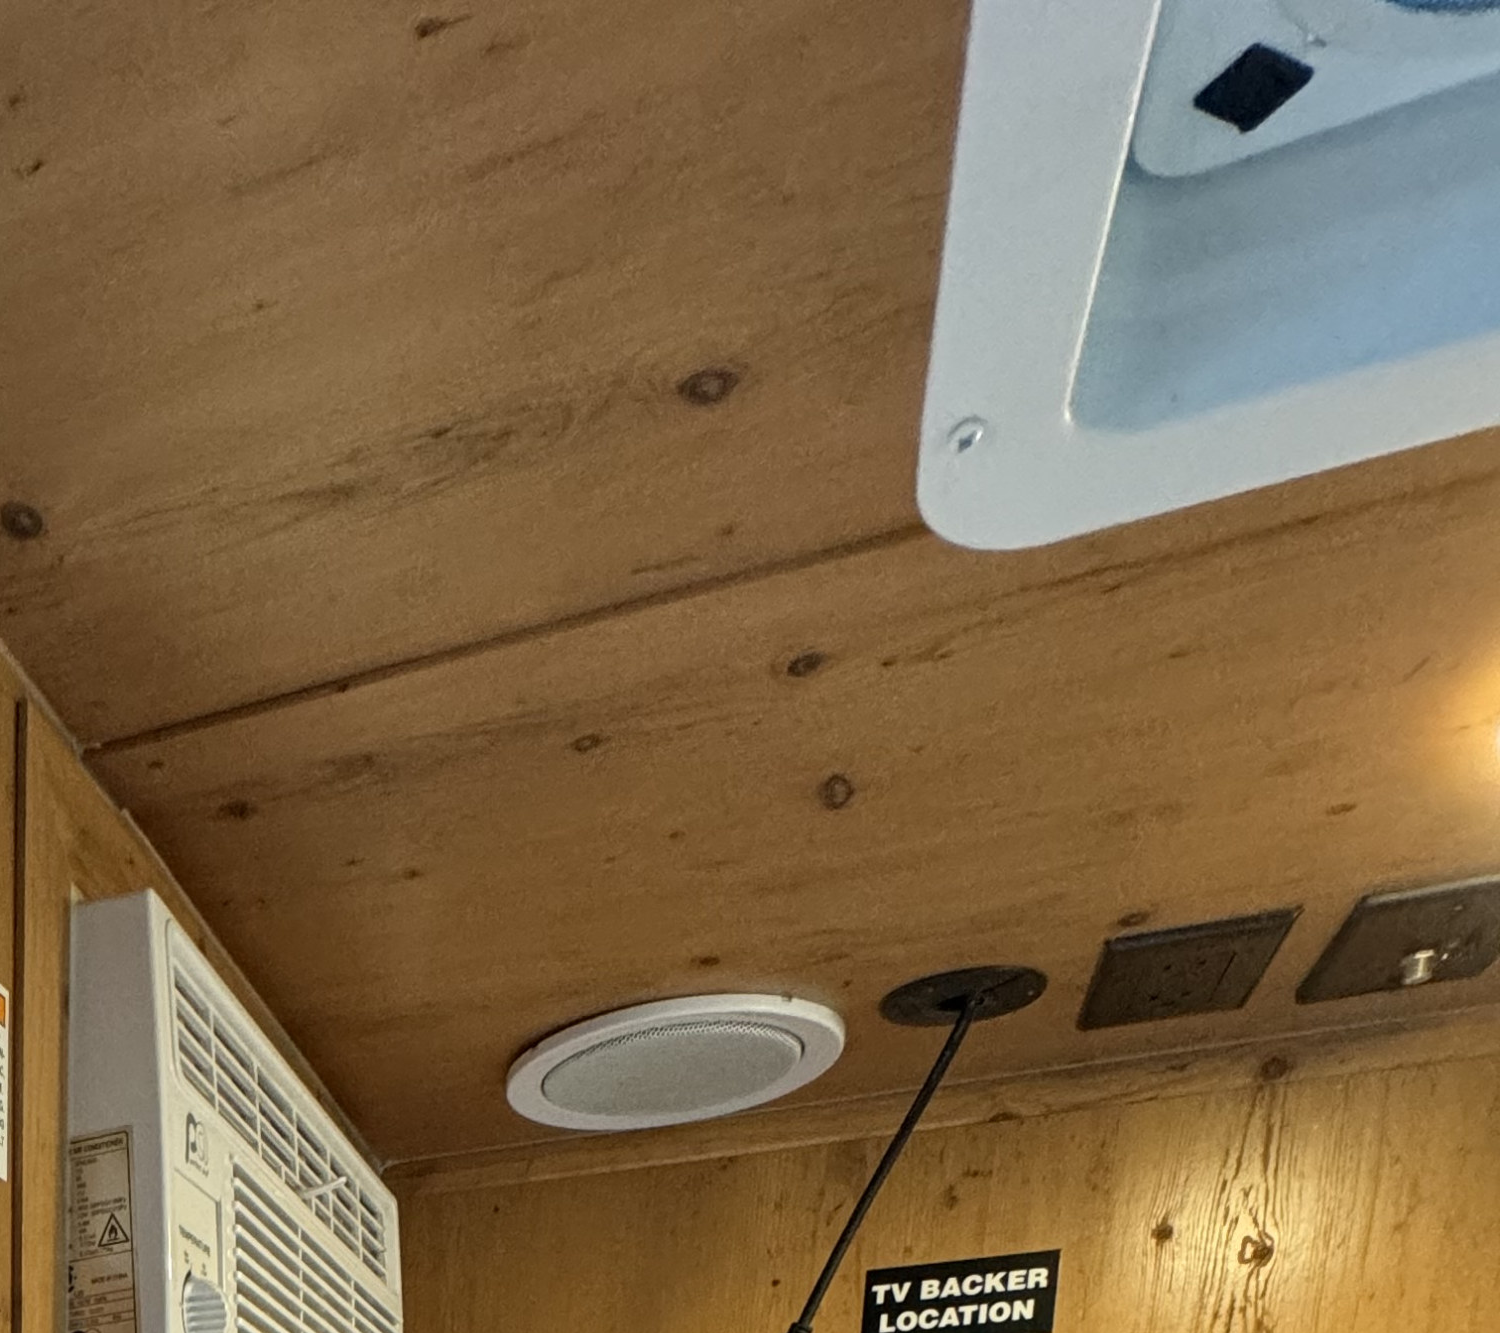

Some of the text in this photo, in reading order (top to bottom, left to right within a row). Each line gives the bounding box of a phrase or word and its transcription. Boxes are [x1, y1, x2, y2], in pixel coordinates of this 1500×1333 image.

[871, 1267, 1049, 1305] TV BACKER
[879, 1298, 1035, 1333] LOCATION
